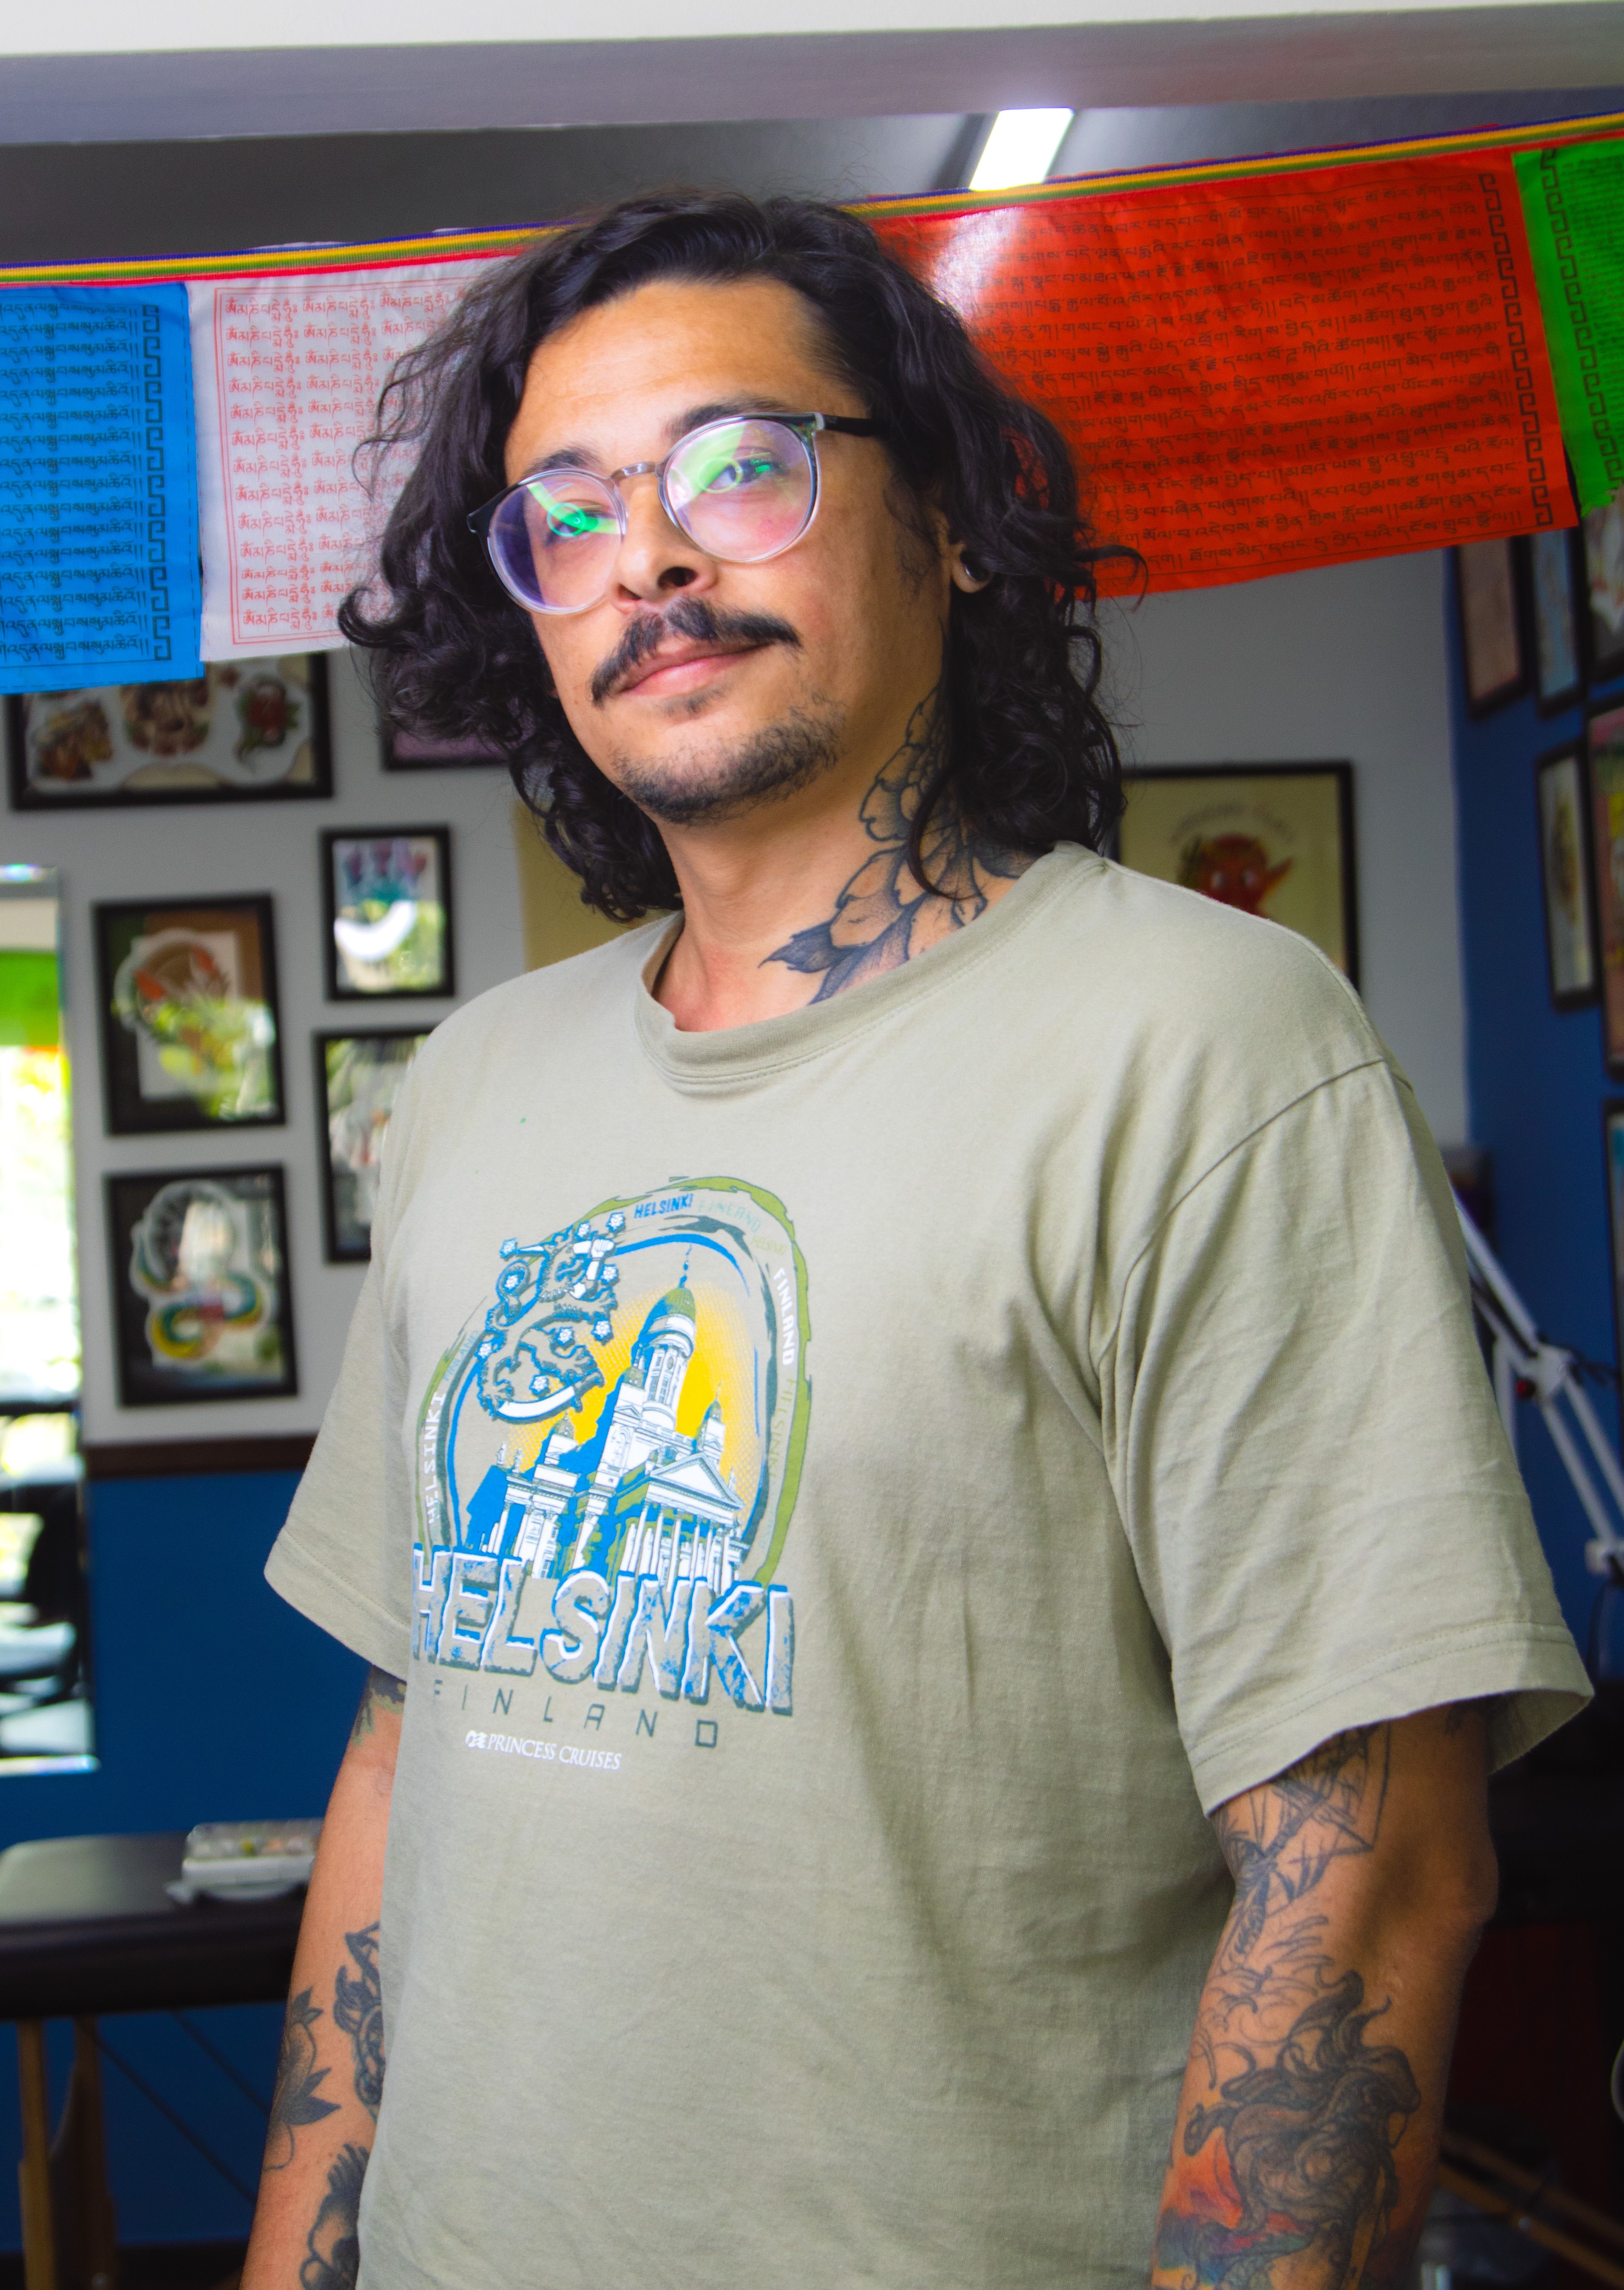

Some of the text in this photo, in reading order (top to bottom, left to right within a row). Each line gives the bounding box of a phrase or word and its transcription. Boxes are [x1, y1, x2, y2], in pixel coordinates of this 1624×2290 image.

[633, 1193, 694, 1219] HELSINKI
[773, 1267, 796, 1366] FINLAND
[424, 1391, 447, 1525] HELSINKI
[412, 1542, 795, 1717] HELSINKI
[486, 1733, 623, 1771] PRINCESS CRUISES
